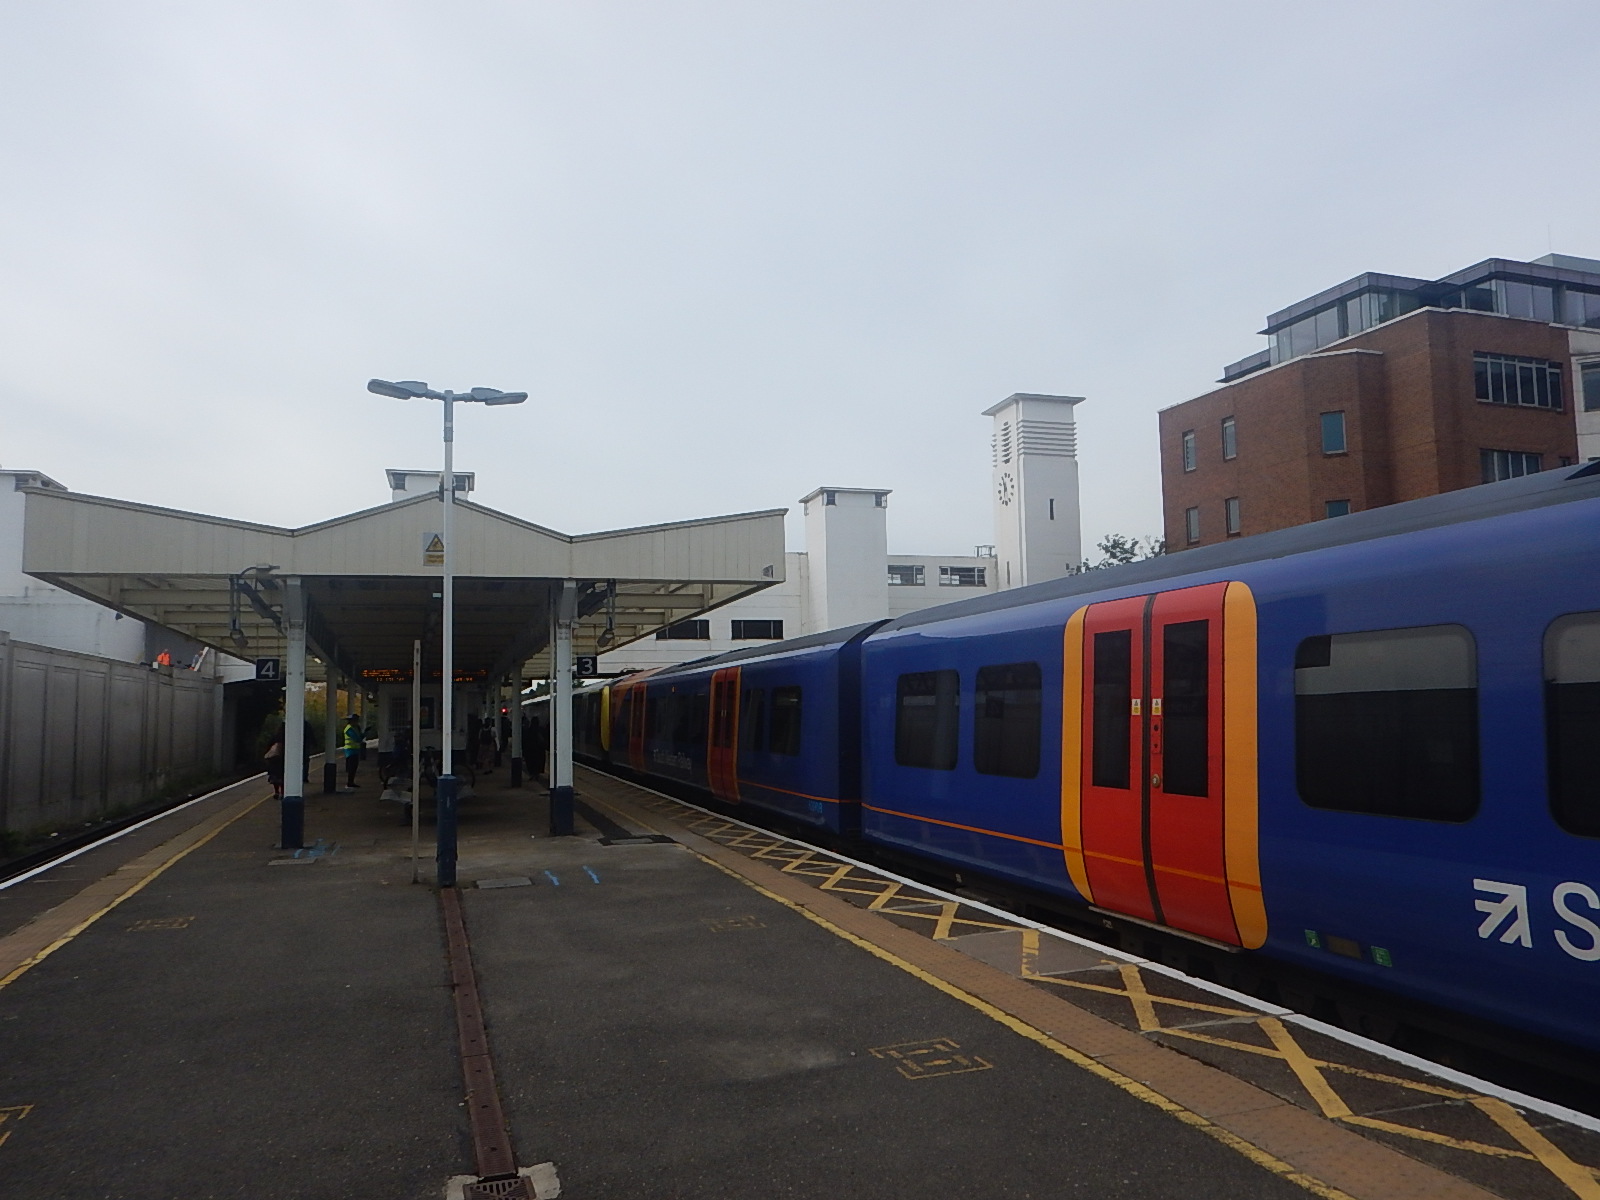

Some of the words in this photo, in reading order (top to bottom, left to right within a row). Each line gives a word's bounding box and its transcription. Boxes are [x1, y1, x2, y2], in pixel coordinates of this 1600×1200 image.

[260, 661, 275, 678] 4
[581, 658, 593, 675] 3
[1552, 881, 1600, 962] S
